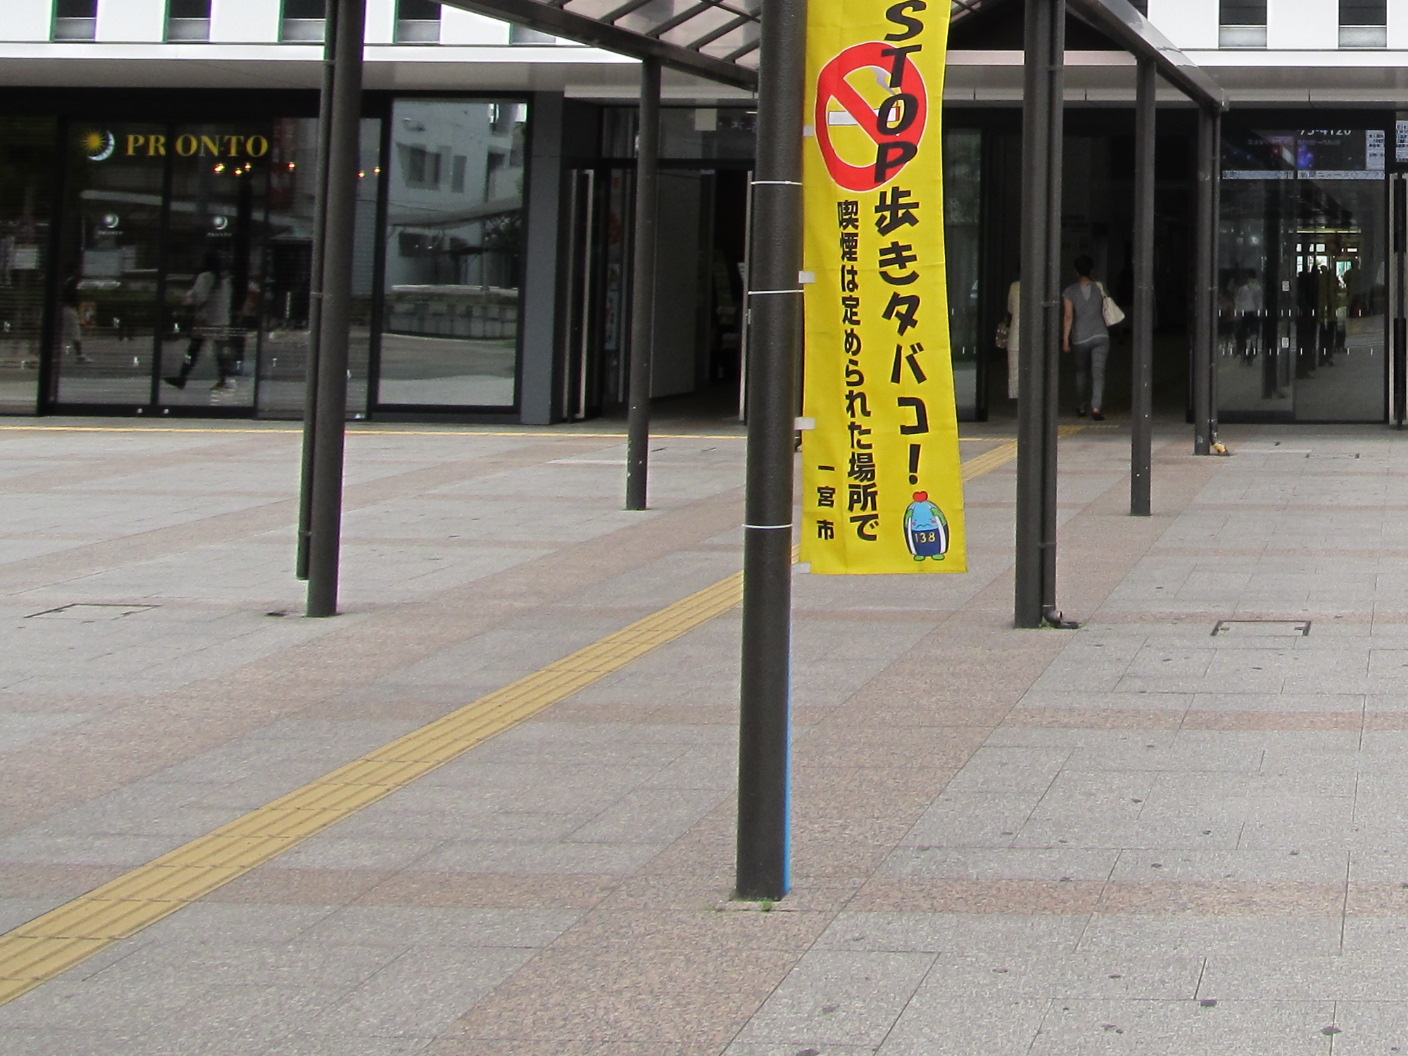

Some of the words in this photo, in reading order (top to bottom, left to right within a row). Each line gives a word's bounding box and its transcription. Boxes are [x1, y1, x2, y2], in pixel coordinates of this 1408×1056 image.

[126, 133, 268, 157] PRONTO
[837, 200, 879, 542] 喫煙は定められた場所で
[816, 464, 836, 541] 一宮市
[914, 532, 936, 543] 138
